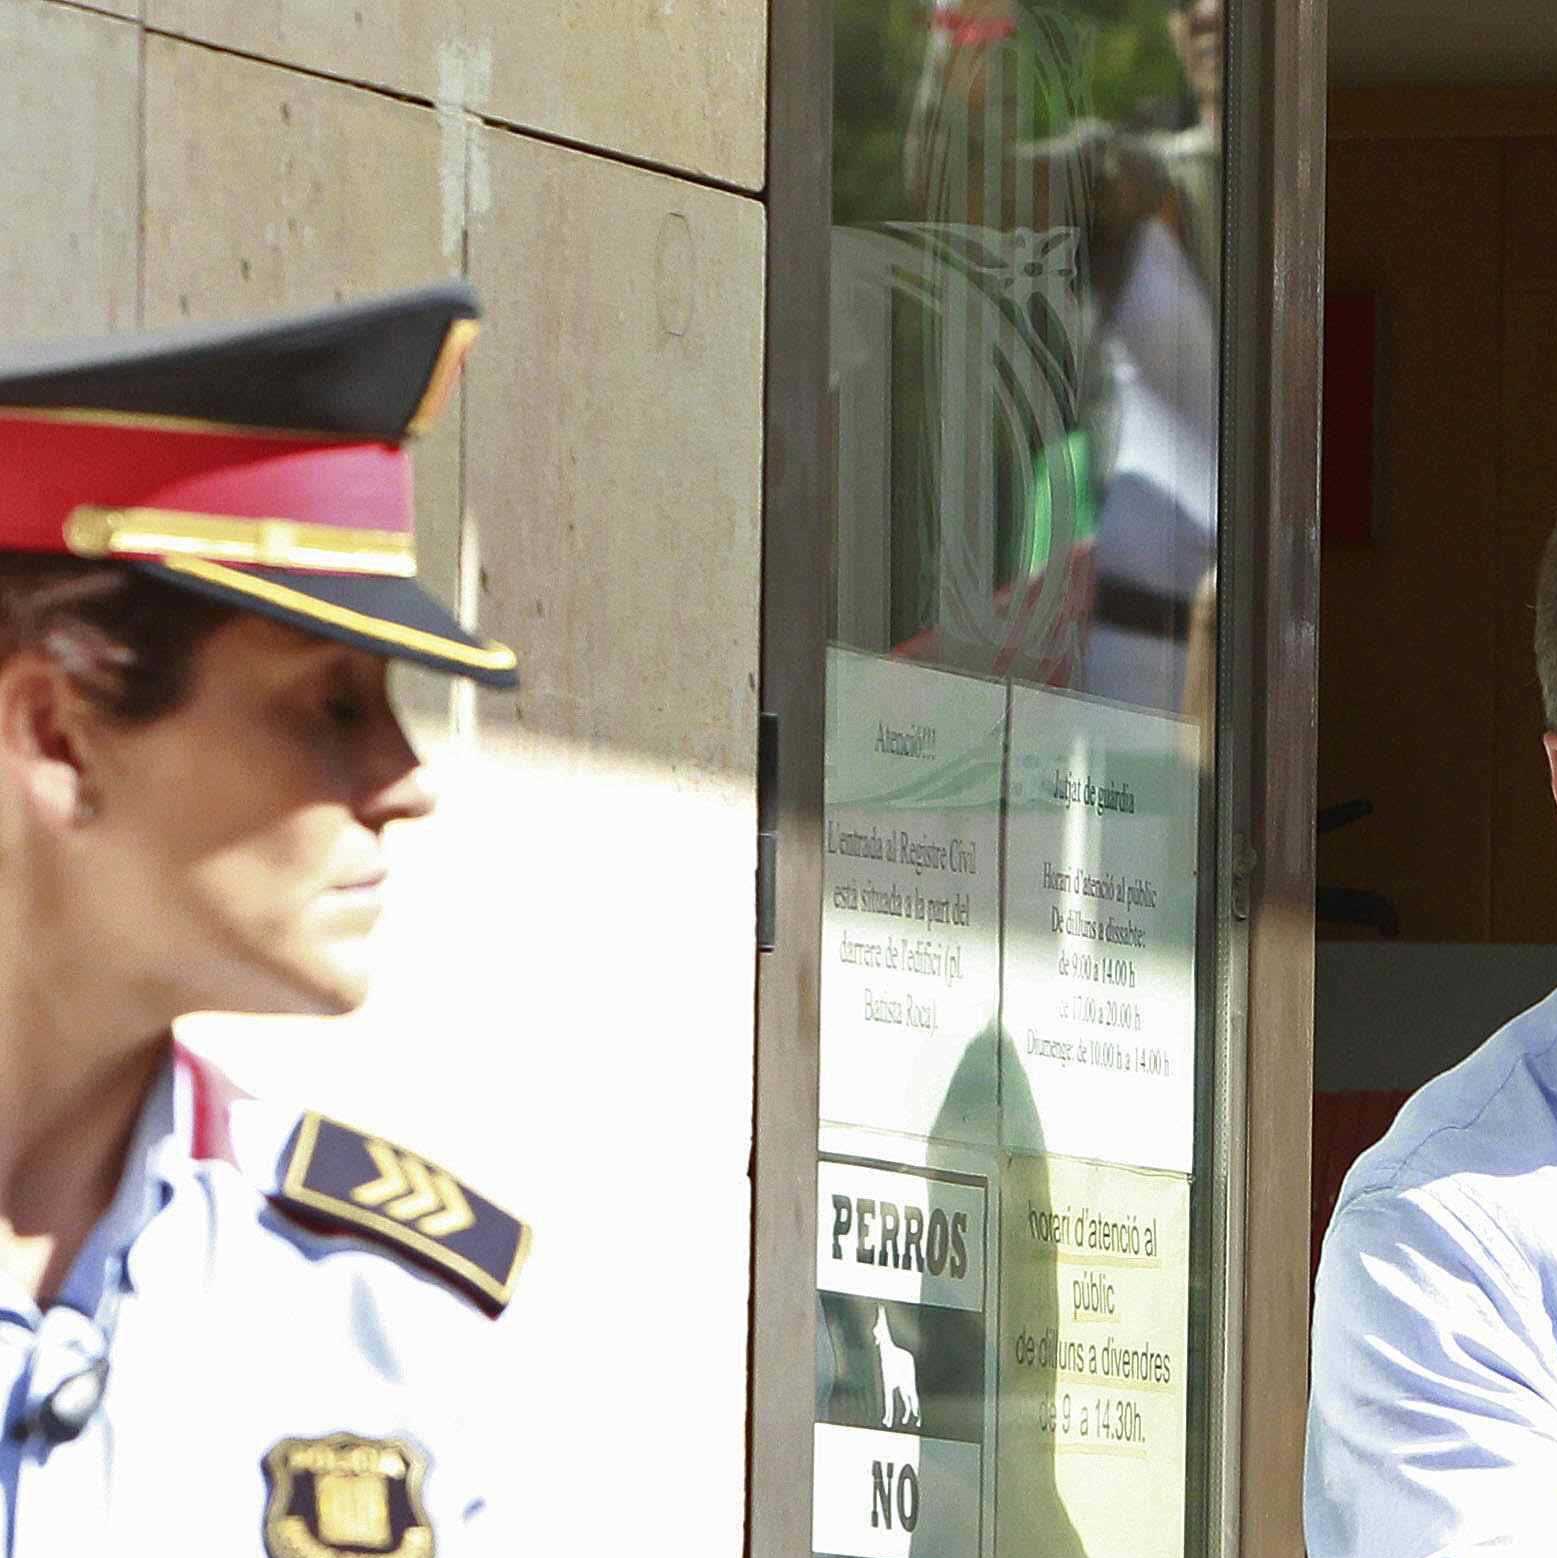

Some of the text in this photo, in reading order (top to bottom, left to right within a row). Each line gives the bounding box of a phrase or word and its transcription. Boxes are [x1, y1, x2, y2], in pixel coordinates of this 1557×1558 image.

[1053, 768, 1082, 809] Jutjat
[1084, 775, 1096, 806] de
[885, 830, 897, 863] al
[900, 830, 947, 876] Registre
[1043, 861, 1071, 893] Horari
[1116, 876, 1125, 903] al
[904, 895, 912, 919] a
[915, 887, 925, 920] la
[951, 892, 970, 927] del
[1051, 905, 1063, 933] De
[840, 929, 882, 968] darrere
[885, 935, 898, 970] de
[1058, 949, 1069, 977] de
[1102, 957, 1127, 986] 14.00
[831, 1194, 968, 1280] PERROS
[1027, 1199, 1157, 1257] horari d'atenció al
[1073, 1271, 1115, 1321] públic
[1015, 1326, 1171, 1384] de dilluns a divendres
[1039, 1391, 1146, 1443] de 9 a 14.30h.
[871, 1459, 920, 1534] NO
